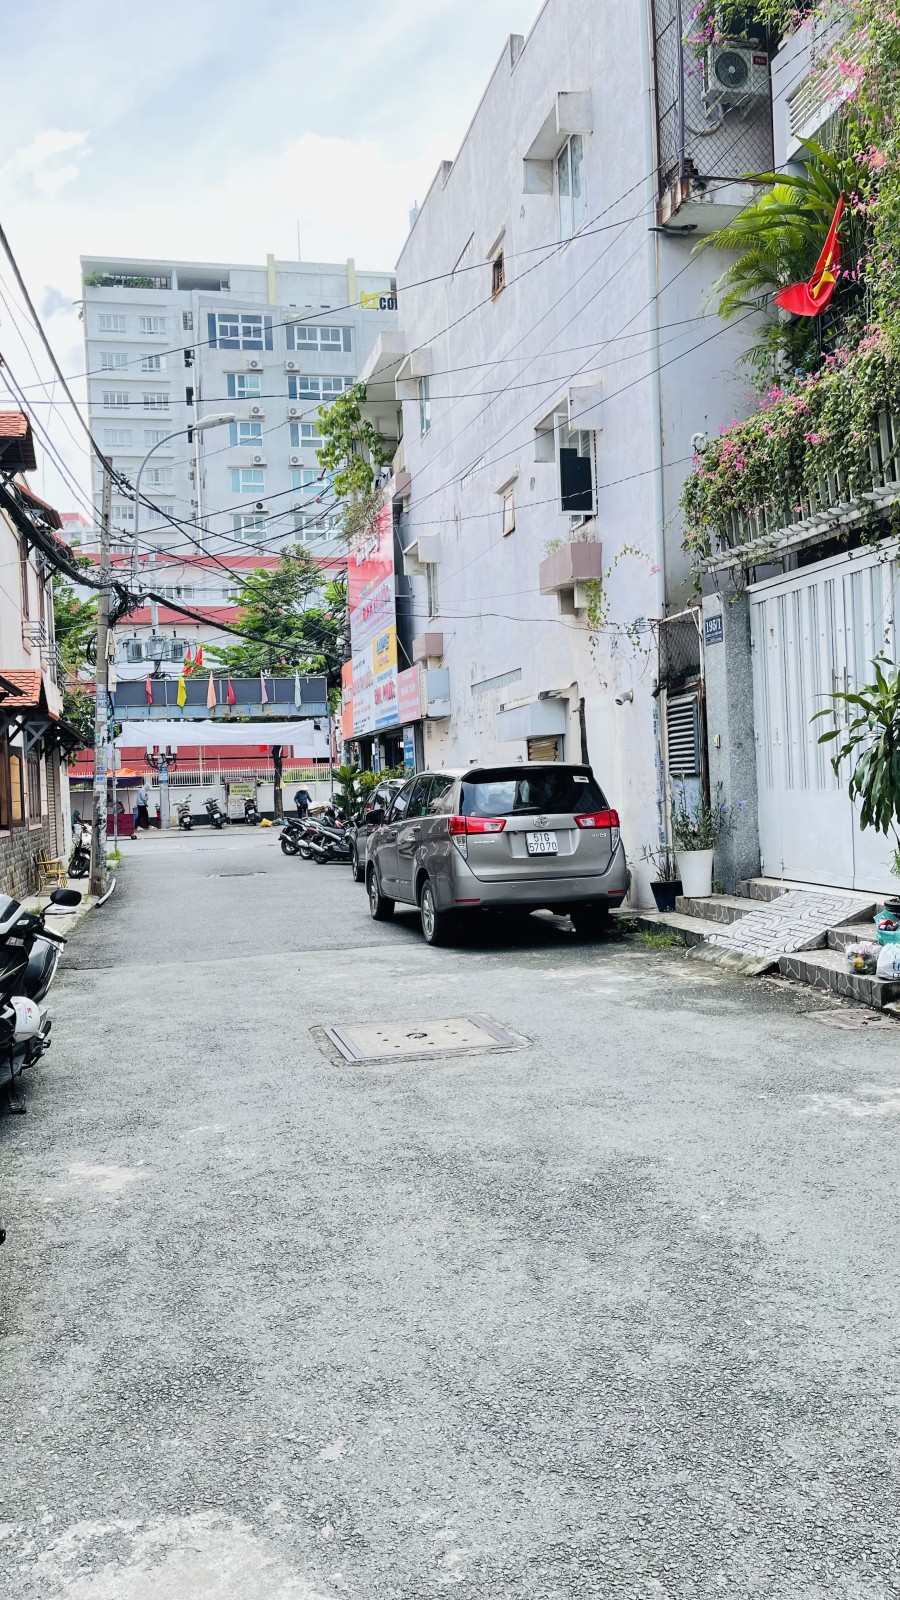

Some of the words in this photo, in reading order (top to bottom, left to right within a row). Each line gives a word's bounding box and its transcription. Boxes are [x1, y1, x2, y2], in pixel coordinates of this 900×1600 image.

[706, 617, 721, 633] 195/1
[533, 832, 550, 842] 51G
[529, 842, 557, 852] 57070
